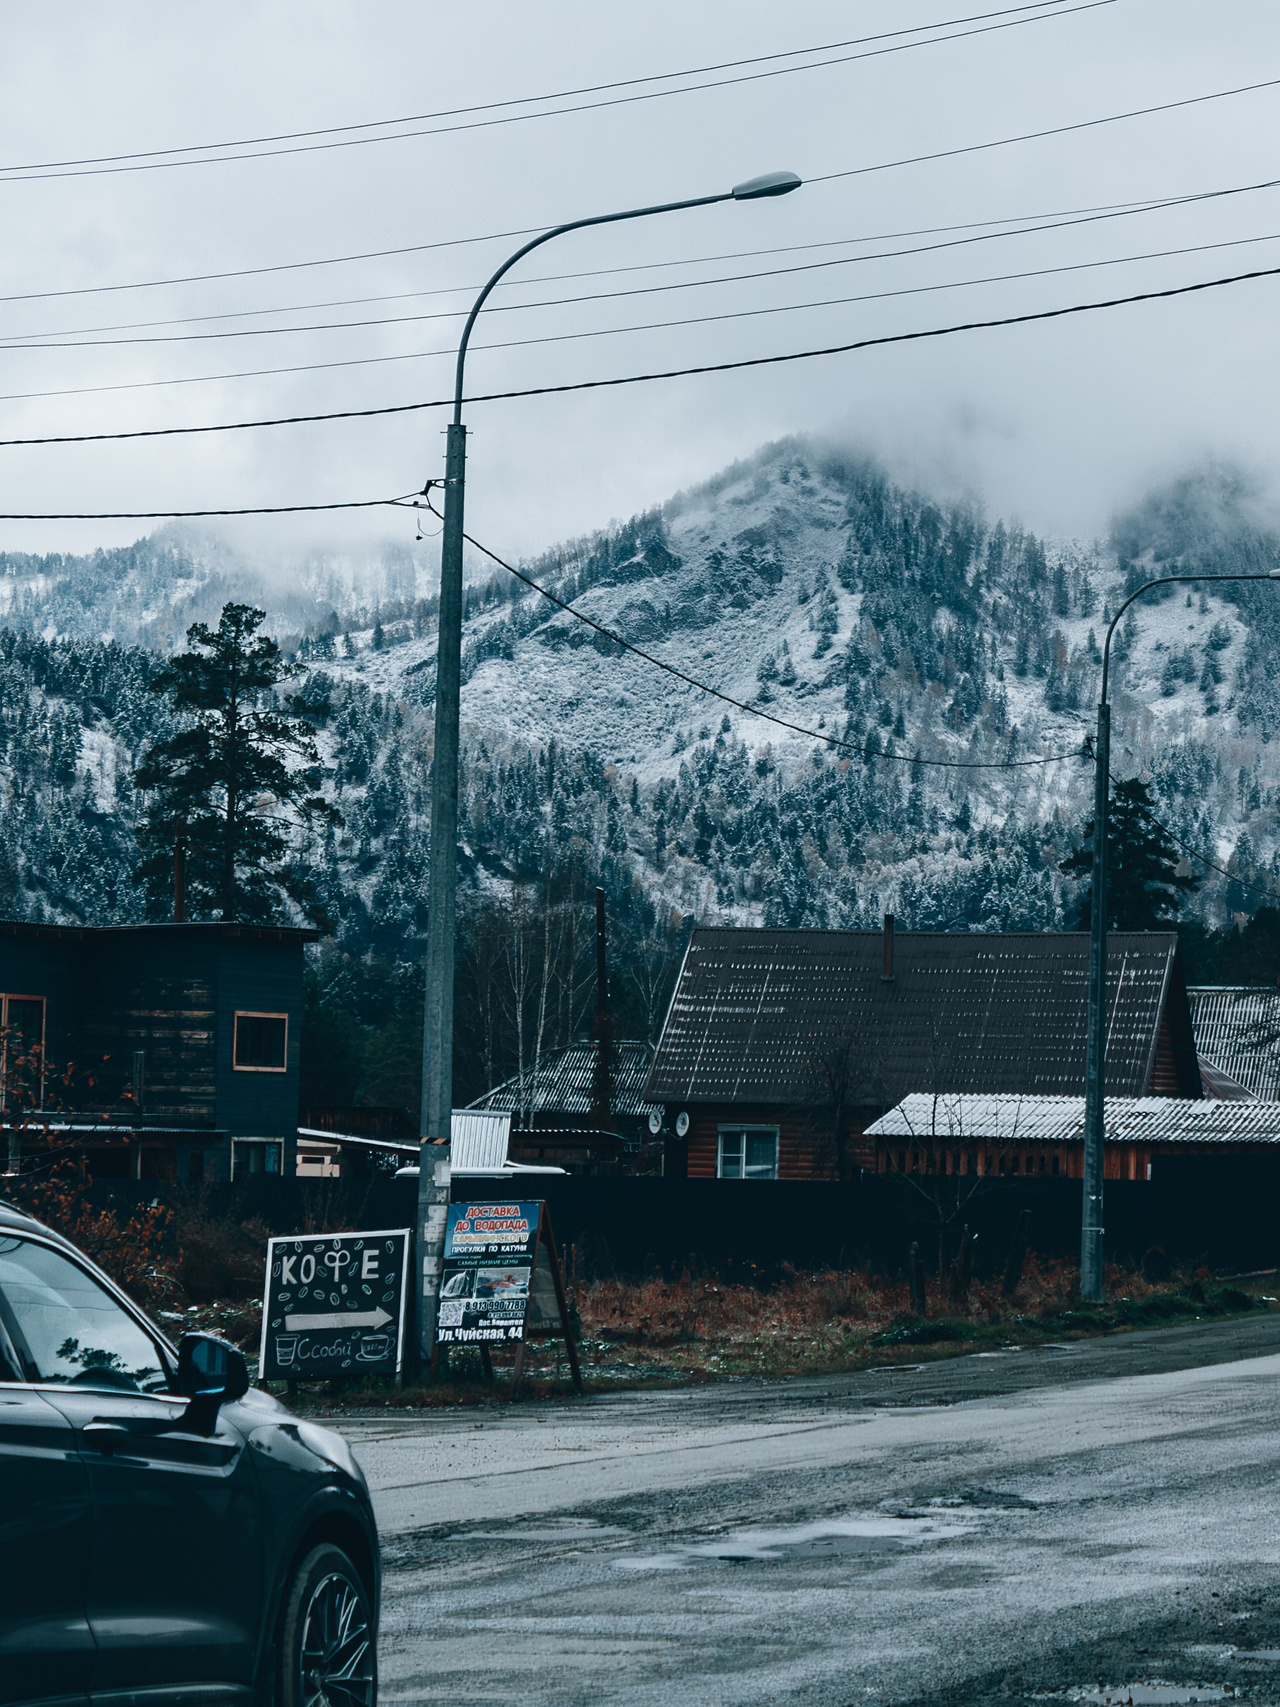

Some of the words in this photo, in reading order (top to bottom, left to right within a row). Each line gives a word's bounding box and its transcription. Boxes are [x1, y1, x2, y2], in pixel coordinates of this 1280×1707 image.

[465, 1205, 521, 1219] ДОСТАВКА
[454, 1220, 471, 1233] ДО
[474, 1218, 529, 1232] ВОДОПАДА
[451, 1245, 486, 1253] ПРОГУЛКИ
[488, 1245, 499, 1253] ПО
[501, 1244, 527, 1252] КАТУНИ
[282, 1249, 380, 1285] КОФЕ
[465, 1301, 471, 1311] 8
[472, 1301, 488, 1311] 913
[508, 1326, 524, 1339] 44
